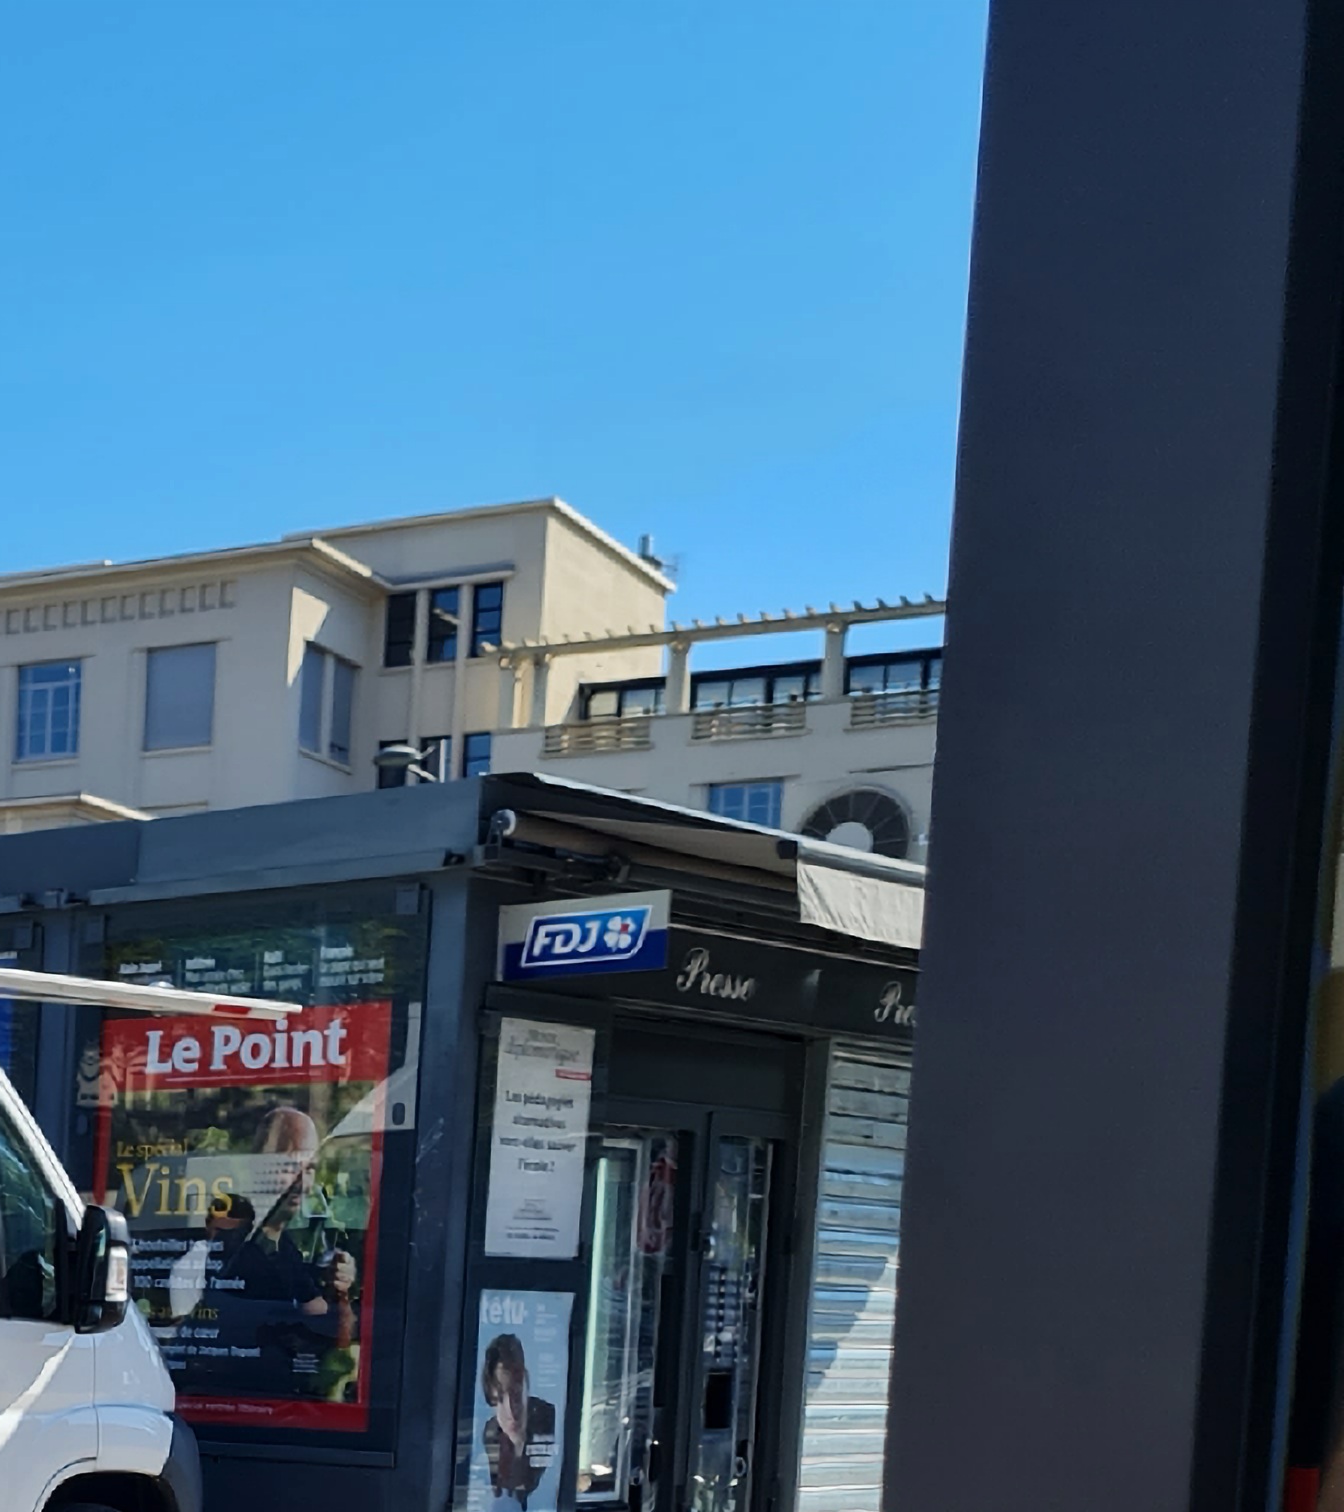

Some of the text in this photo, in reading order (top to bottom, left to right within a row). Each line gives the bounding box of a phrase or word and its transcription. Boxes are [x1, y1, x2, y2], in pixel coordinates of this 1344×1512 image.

[532, 920, 601, 957] FDJ
[676, 947, 756, 1001] Presse
[145, 1017, 348, 1074] Le Point
[116, 1162, 234, 1219] Vins
